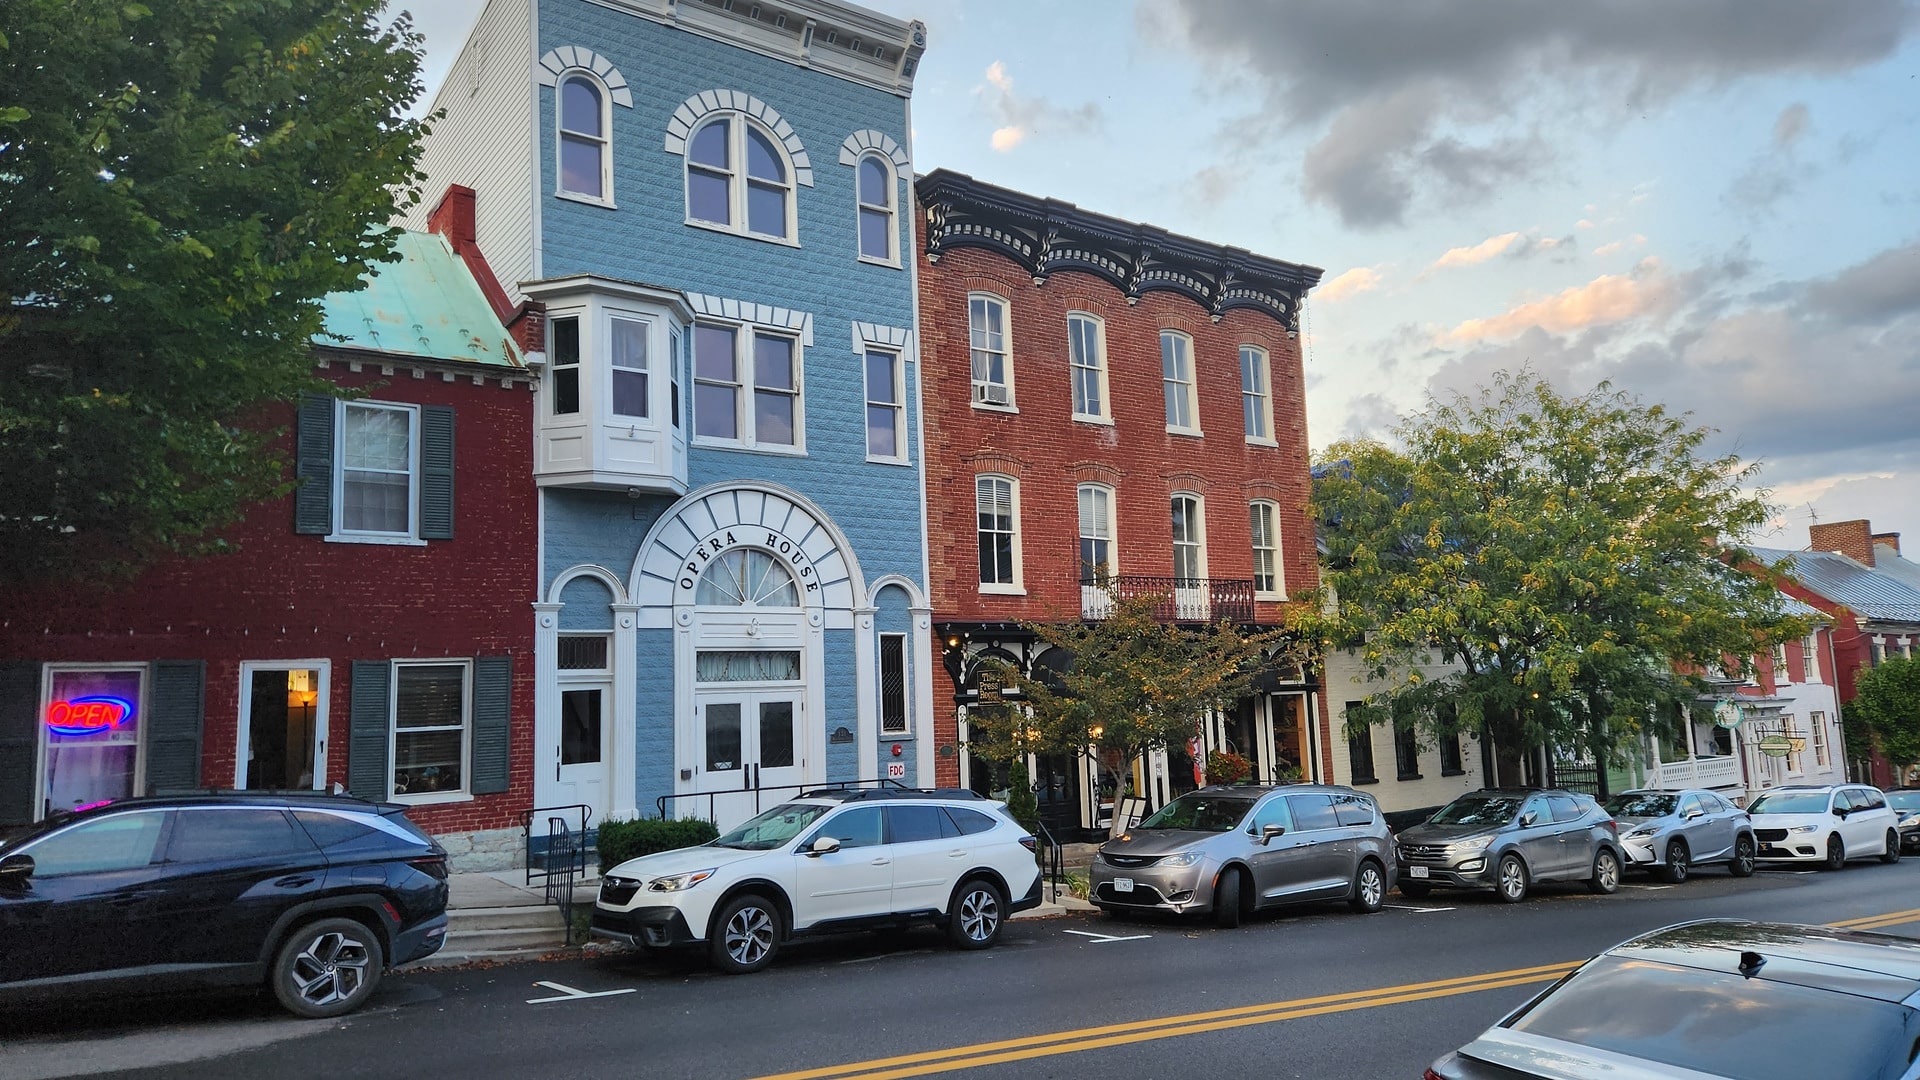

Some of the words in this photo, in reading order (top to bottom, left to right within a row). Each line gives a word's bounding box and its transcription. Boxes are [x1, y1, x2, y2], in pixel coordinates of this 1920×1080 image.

[680, 531, 737, 590] OPERA
[765, 533, 818, 592] HOUSE
[979, 682, 998, 690] Press
[49, 702, 121, 728] OPEN
[889, 765, 904, 776] FDC
